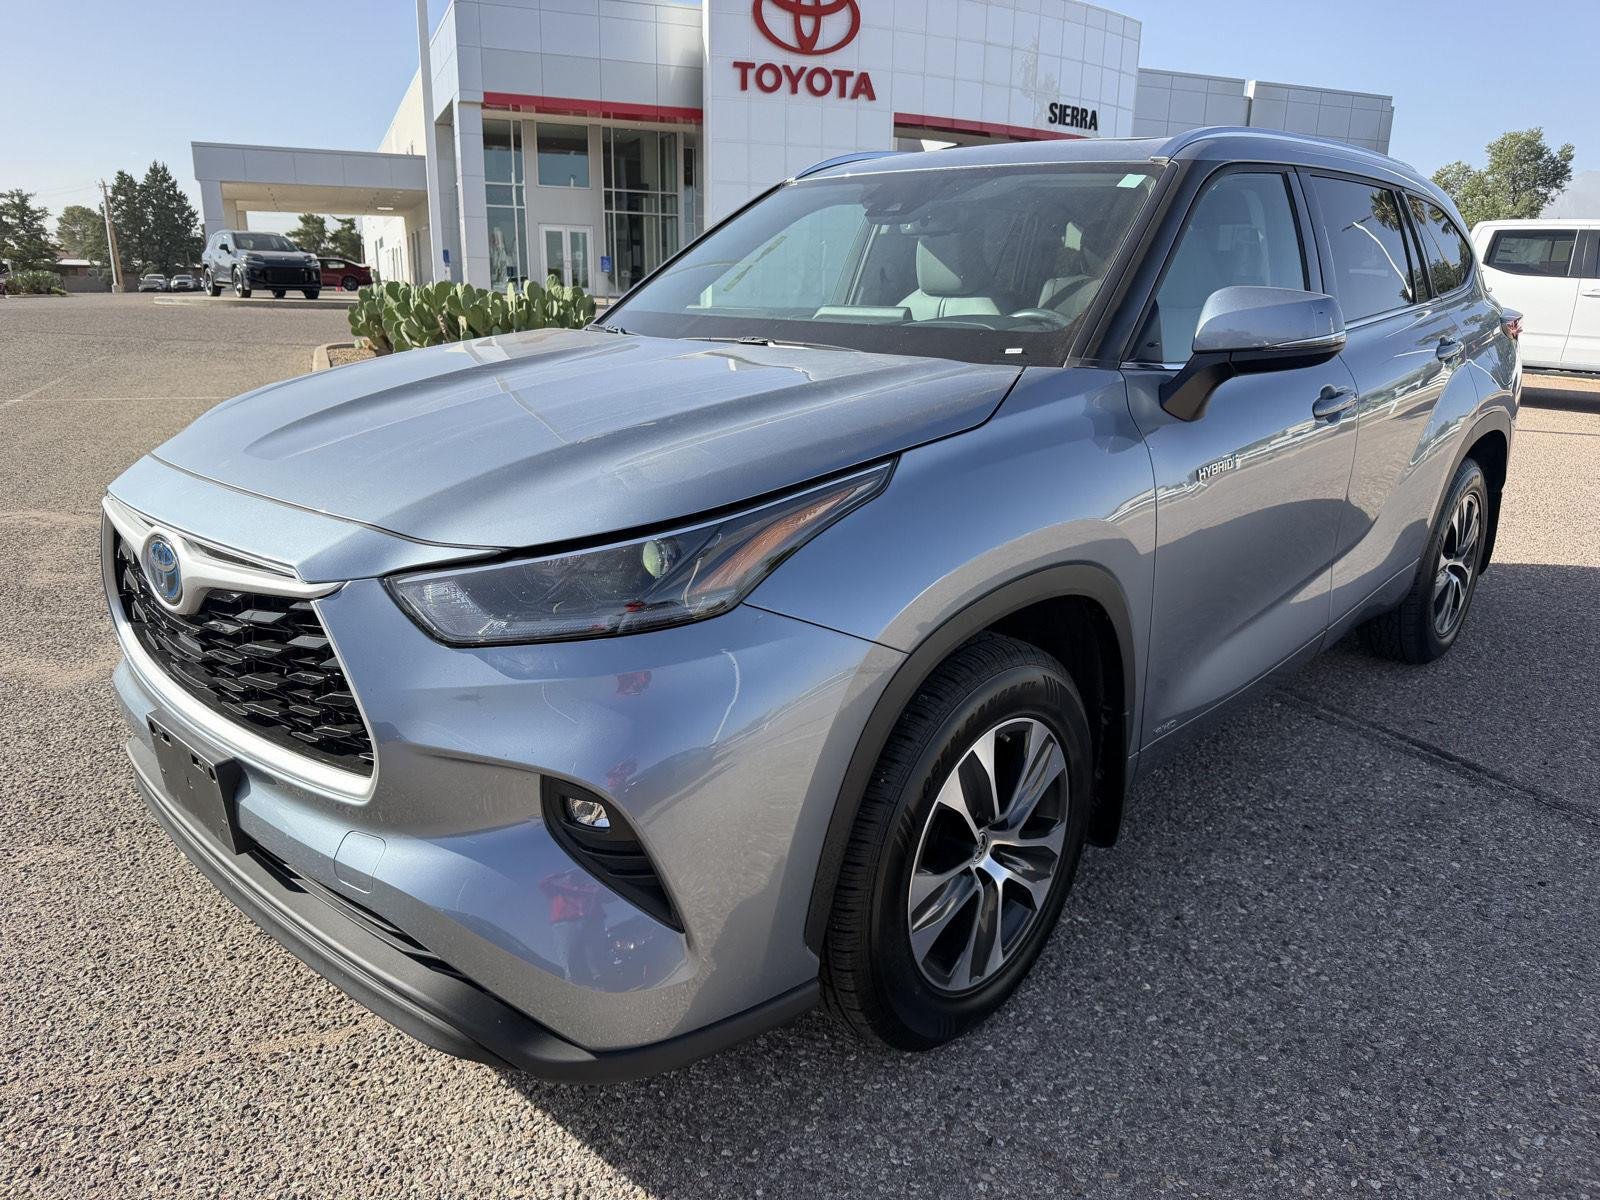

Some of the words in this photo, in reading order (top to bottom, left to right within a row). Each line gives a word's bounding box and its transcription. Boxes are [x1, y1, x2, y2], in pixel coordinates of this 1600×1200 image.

[733, 61, 876, 101] TOYOTA
[1048, 102, 1098, 131] SIERRA
[1198, 458, 1234, 481] HYBRID
